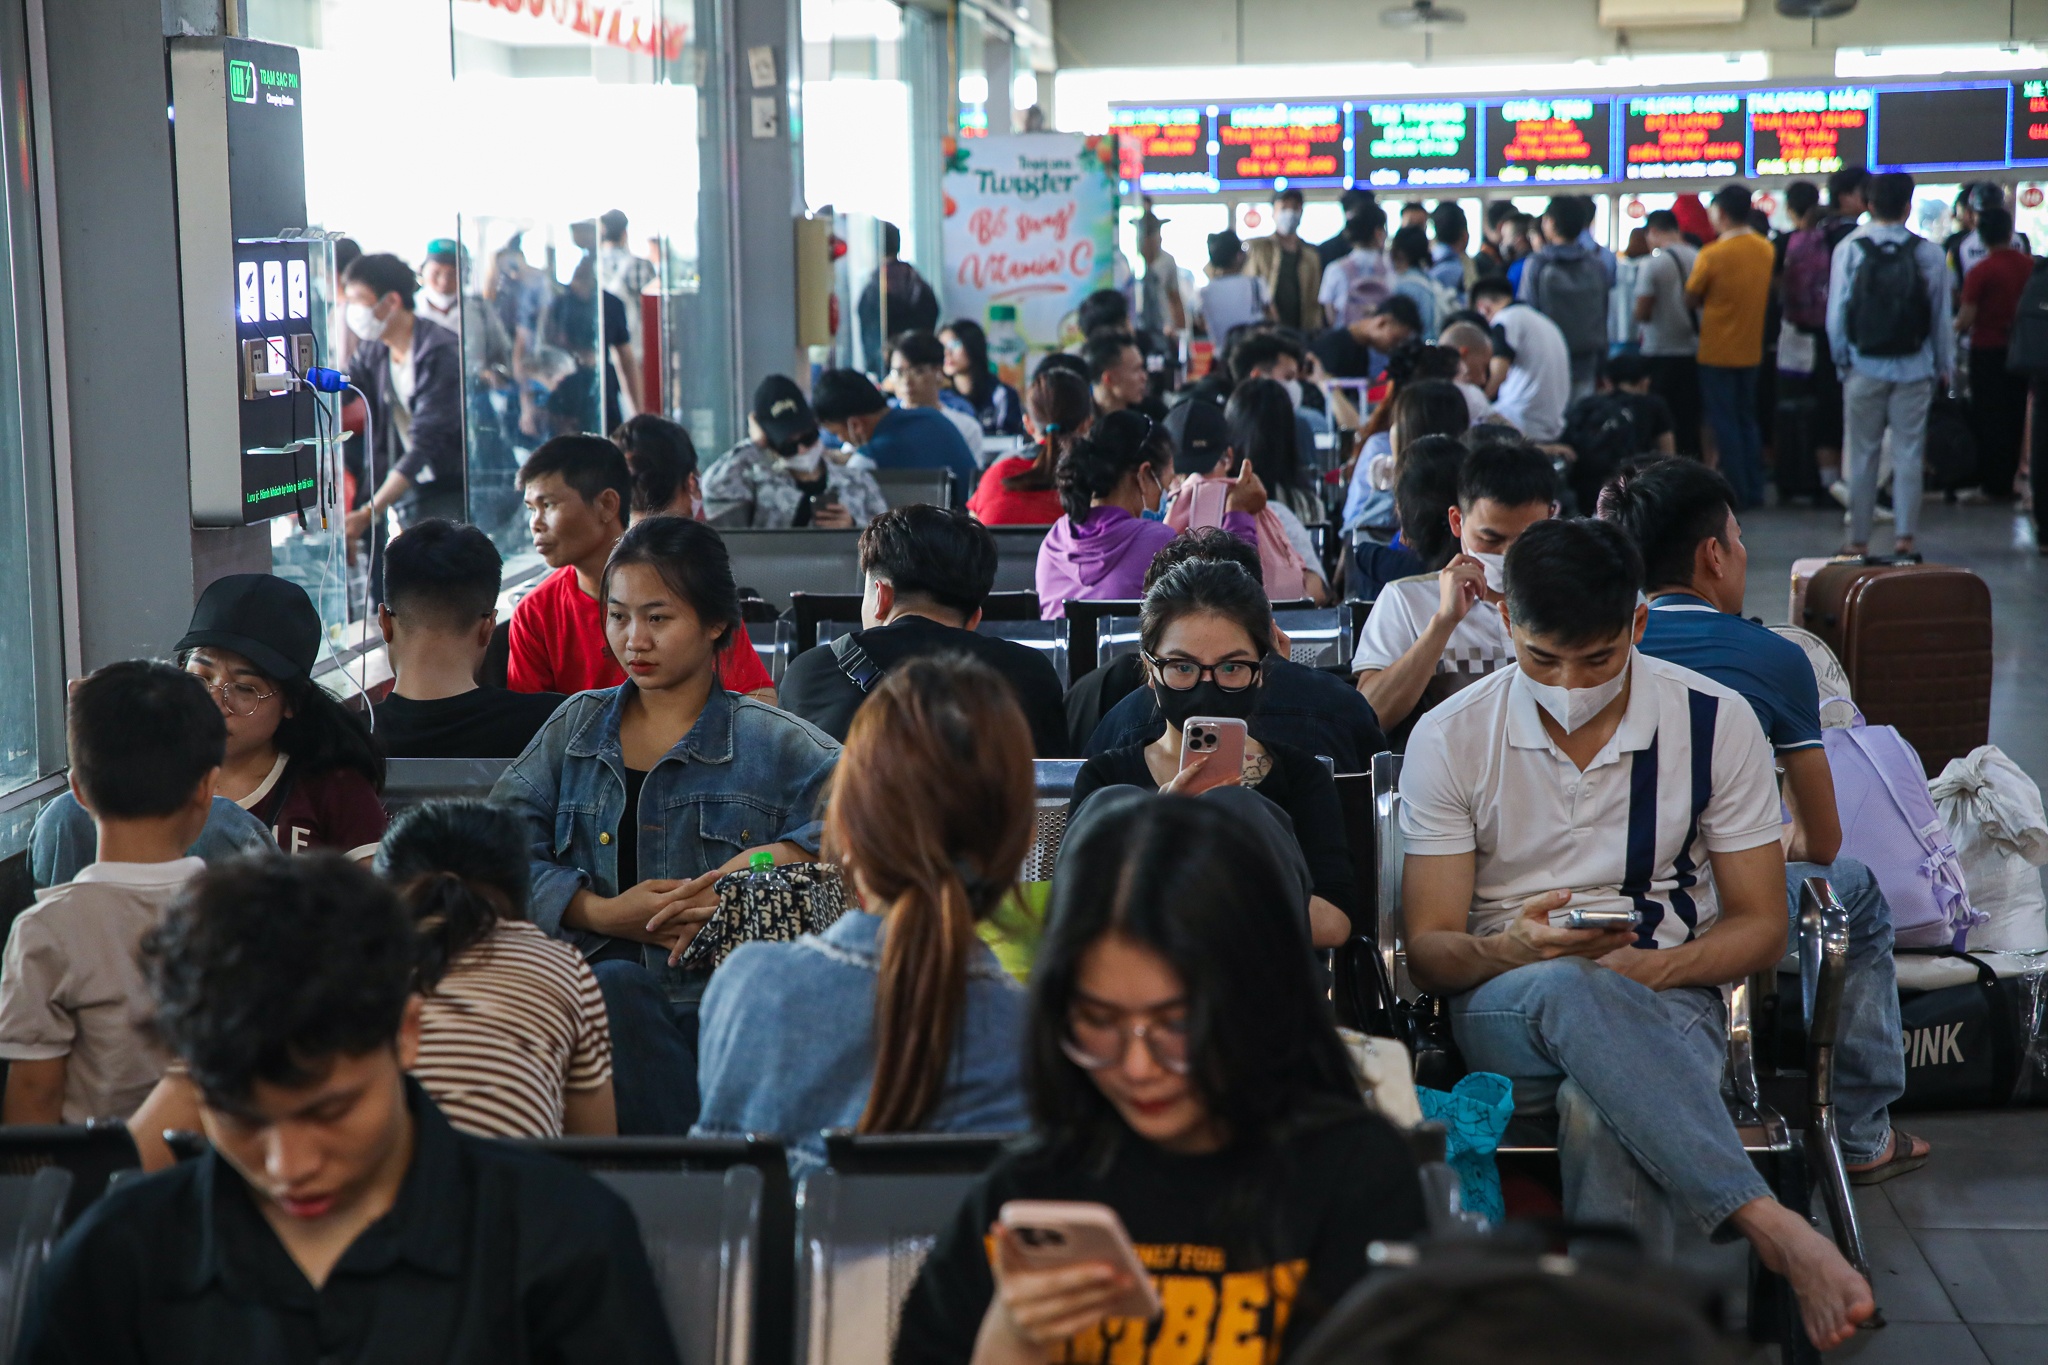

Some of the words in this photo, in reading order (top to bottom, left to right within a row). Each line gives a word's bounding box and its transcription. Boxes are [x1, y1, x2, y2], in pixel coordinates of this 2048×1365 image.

[260, 69, 275, 89] TRẠM
[276, 71, 288, 91] SẠC
[974, 169, 1080, 197] Twister
[957, 248, 1066, 288] Vitamin
[1068, 239, 1095, 278] C
